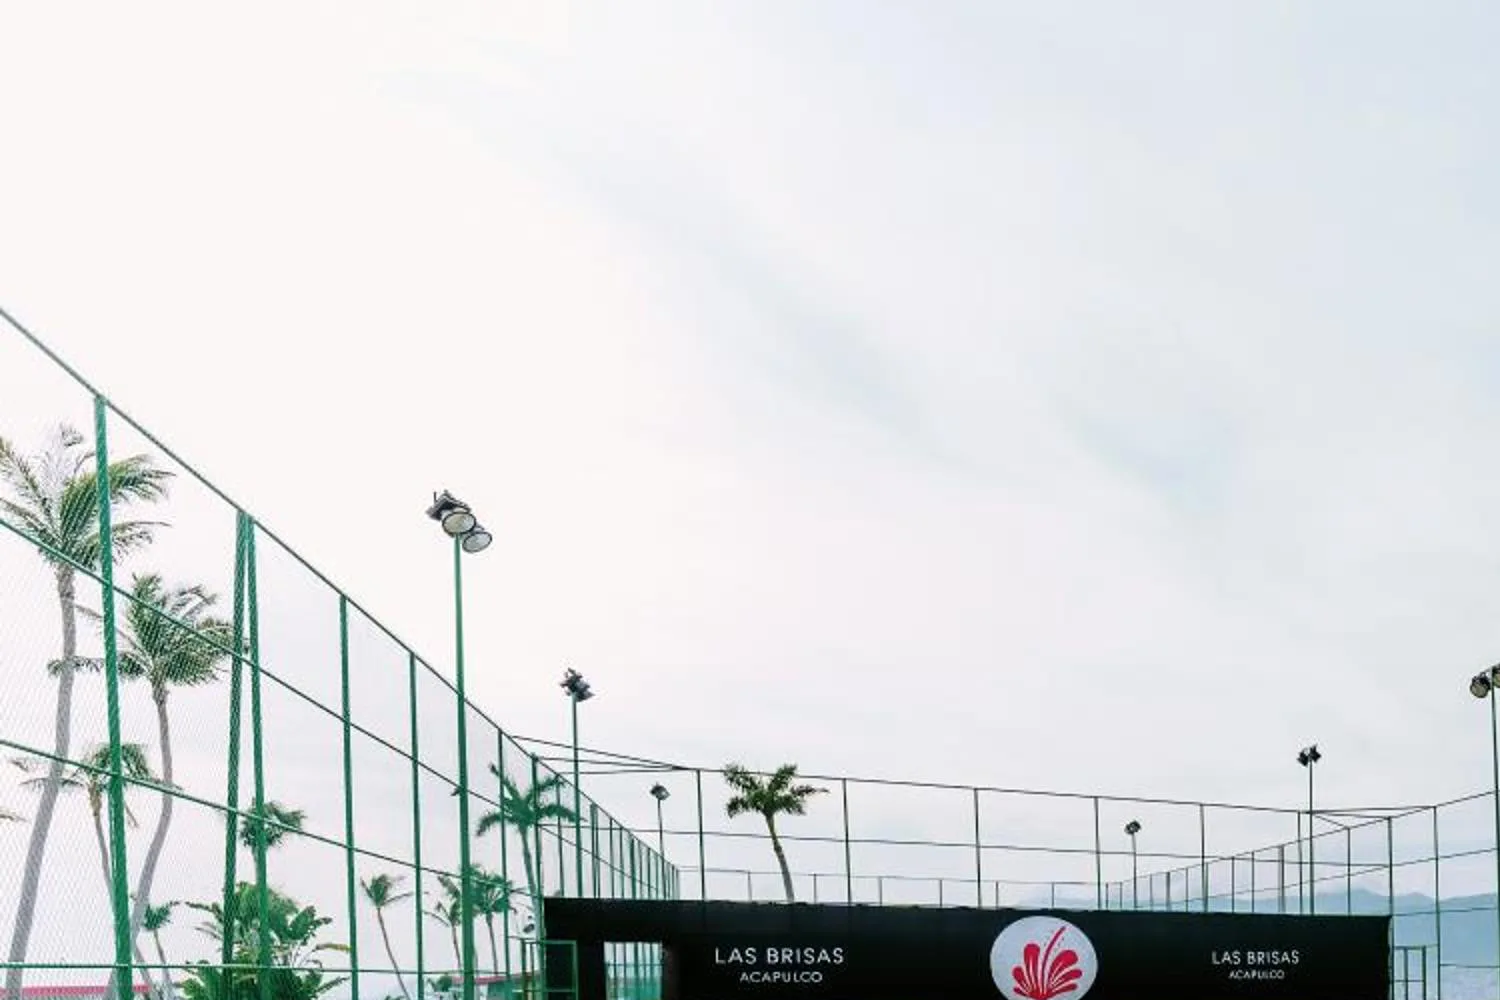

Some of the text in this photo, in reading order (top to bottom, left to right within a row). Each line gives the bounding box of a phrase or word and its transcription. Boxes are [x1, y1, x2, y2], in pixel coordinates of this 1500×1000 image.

[714, 947, 844, 965] LAS BRISAS
[1211, 949, 1300, 965] LAS BRISAS
[739, 971, 823, 983] ACAPULCO
[1228, 969, 1285, 979] ACAPULCO
